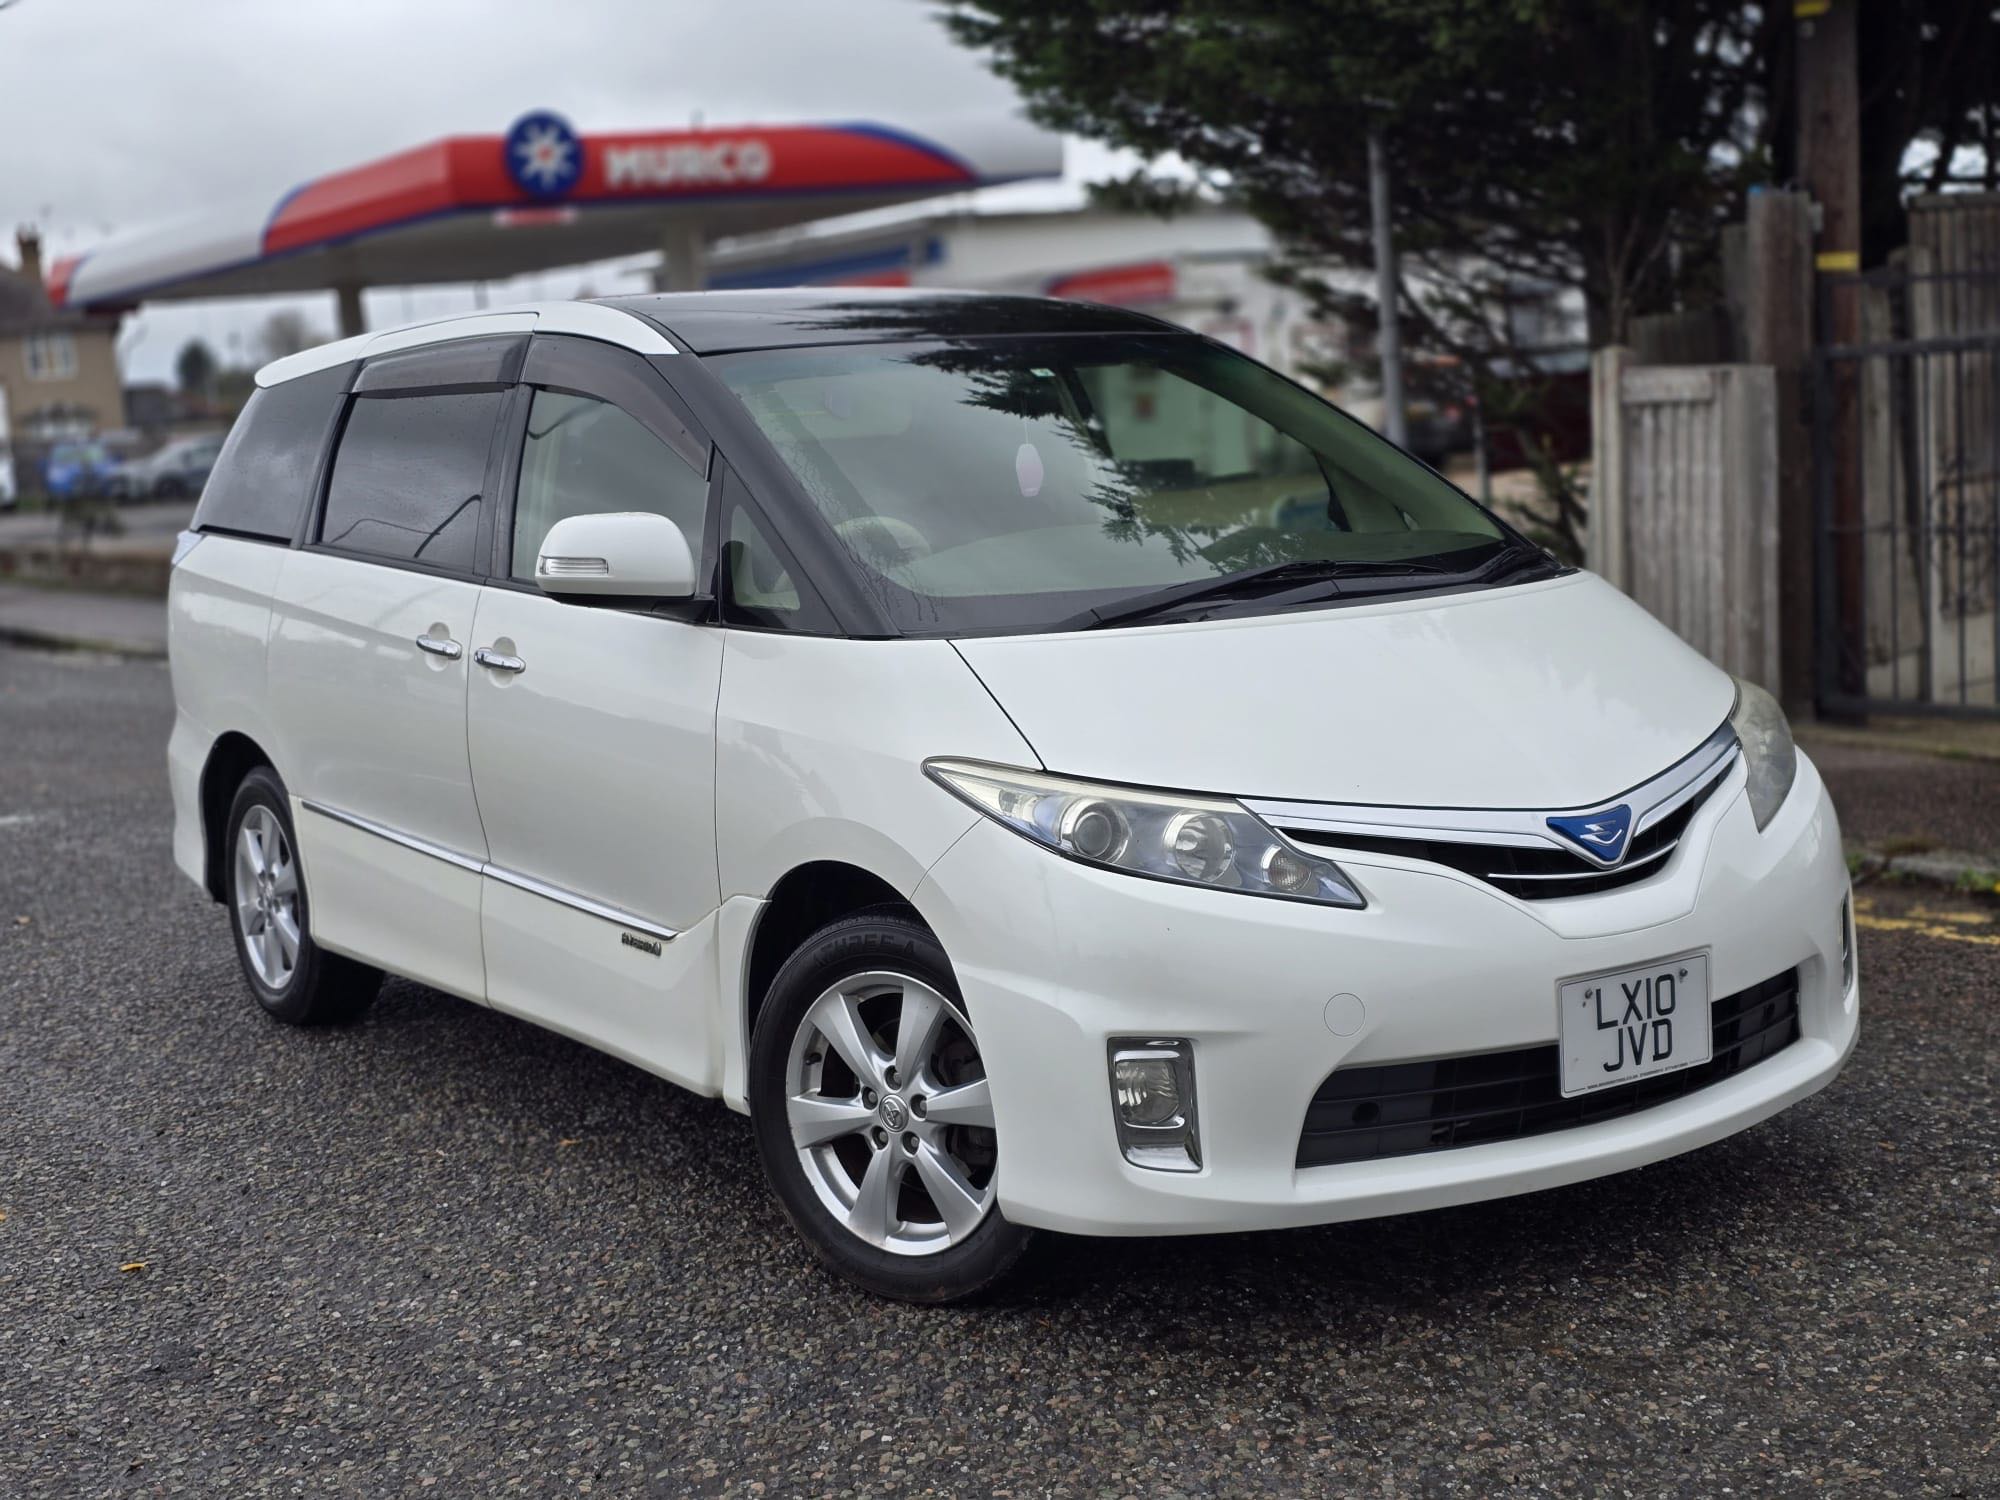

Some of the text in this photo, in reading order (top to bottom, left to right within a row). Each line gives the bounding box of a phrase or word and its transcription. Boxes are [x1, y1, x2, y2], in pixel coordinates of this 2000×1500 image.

[604, 141, 772, 188] MURCO
[1595, 973, 1676, 1030] LX10
[1602, 1017, 1673, 1073] JVD
